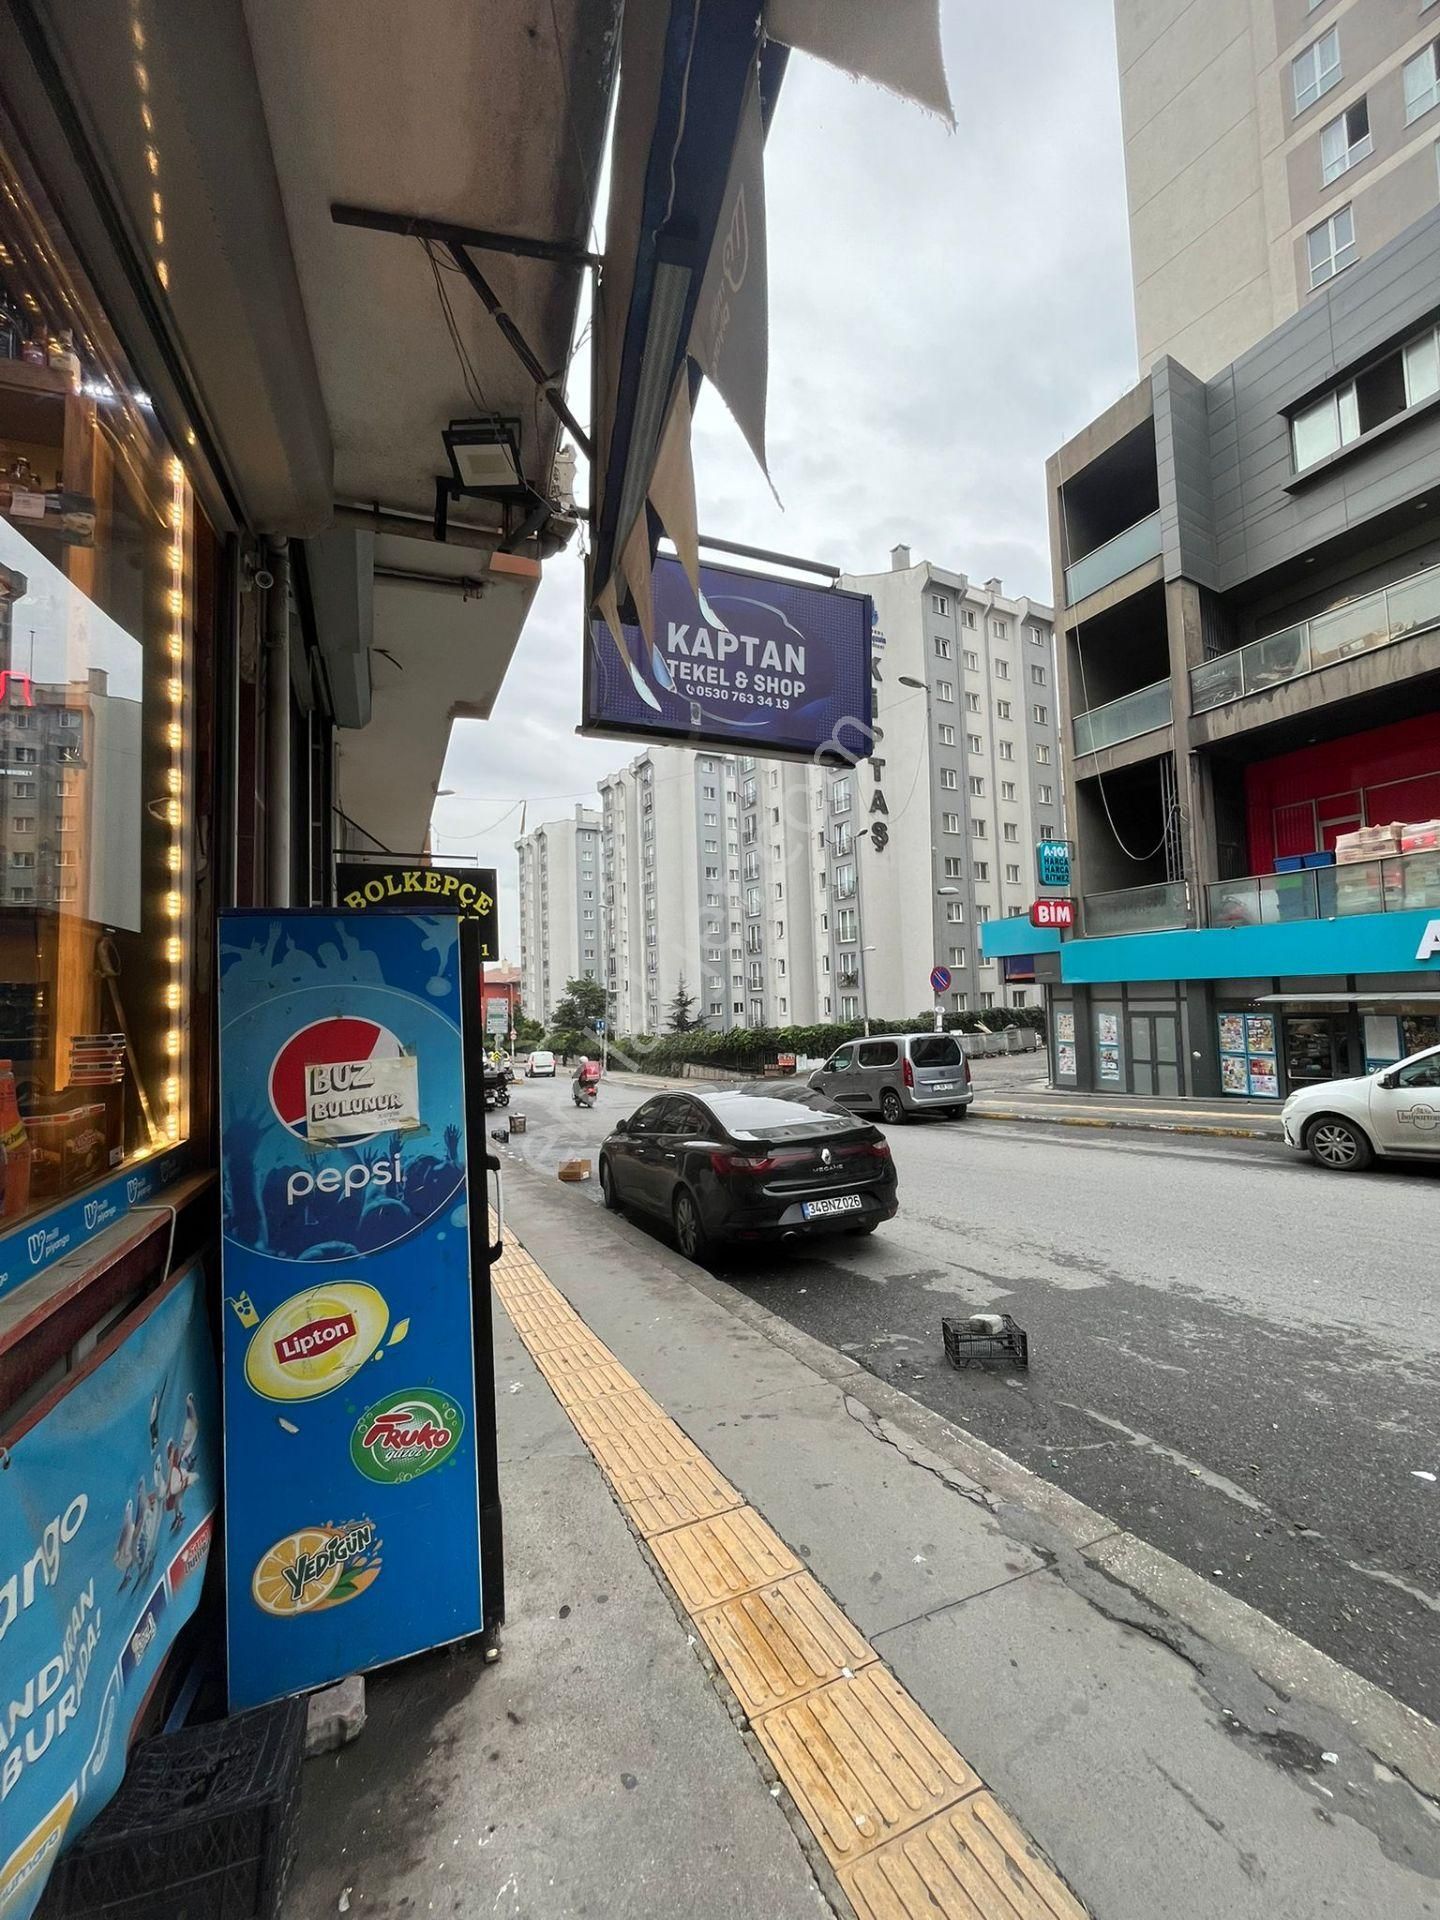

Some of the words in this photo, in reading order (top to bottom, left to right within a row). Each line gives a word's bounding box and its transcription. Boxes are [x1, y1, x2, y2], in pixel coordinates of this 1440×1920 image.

[667, 621, 806, 676] KAPTAN
[666, 658, 730, 687] TEKEL
[735, 670, 749, 689] &
[753, 673, 806, 698] SHOP
[696, 685, 729, 700] 0530
[731, 691, 754, 704] 763
[757, 697, 773, 707] 34
[776, 698, 790, 710] 19
[343, 871, 494, 916] BOLKEPÇE
[1038, 901, 1071, 923] BİM
[310, 1062, 376, 1096] BUZ
[311, 1094, 404, 1122] BULUNUR
[286, 1152, 402, 1206] pepsi
[281, 1320, 350, 1359] Lipton
[282, 1524, 373, 1600] YEDİGÜN
